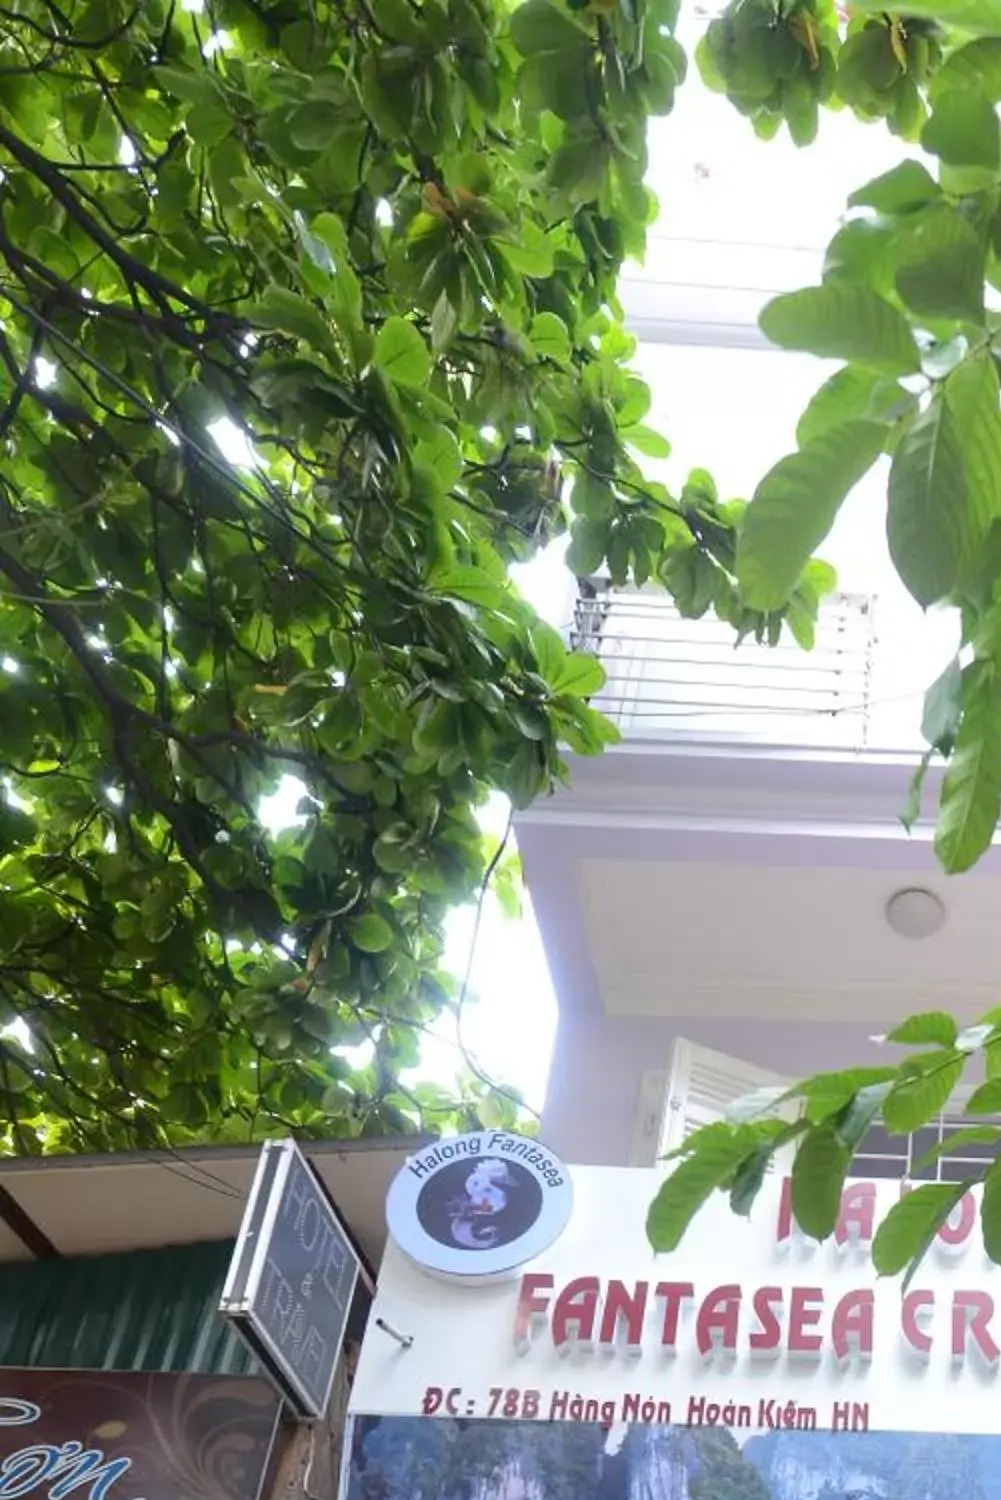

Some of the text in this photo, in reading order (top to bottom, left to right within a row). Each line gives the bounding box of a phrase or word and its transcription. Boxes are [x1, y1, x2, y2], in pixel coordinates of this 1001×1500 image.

[410, 1133, 564, 1188] Halong Fantasea
[284, 1167, 349, 1312] HOTEL
[515, 1274, 876, 1359] FANTASEA
[488, 1388, 541, 1420] 78B
[831, 1403, 869, 1432] HN
